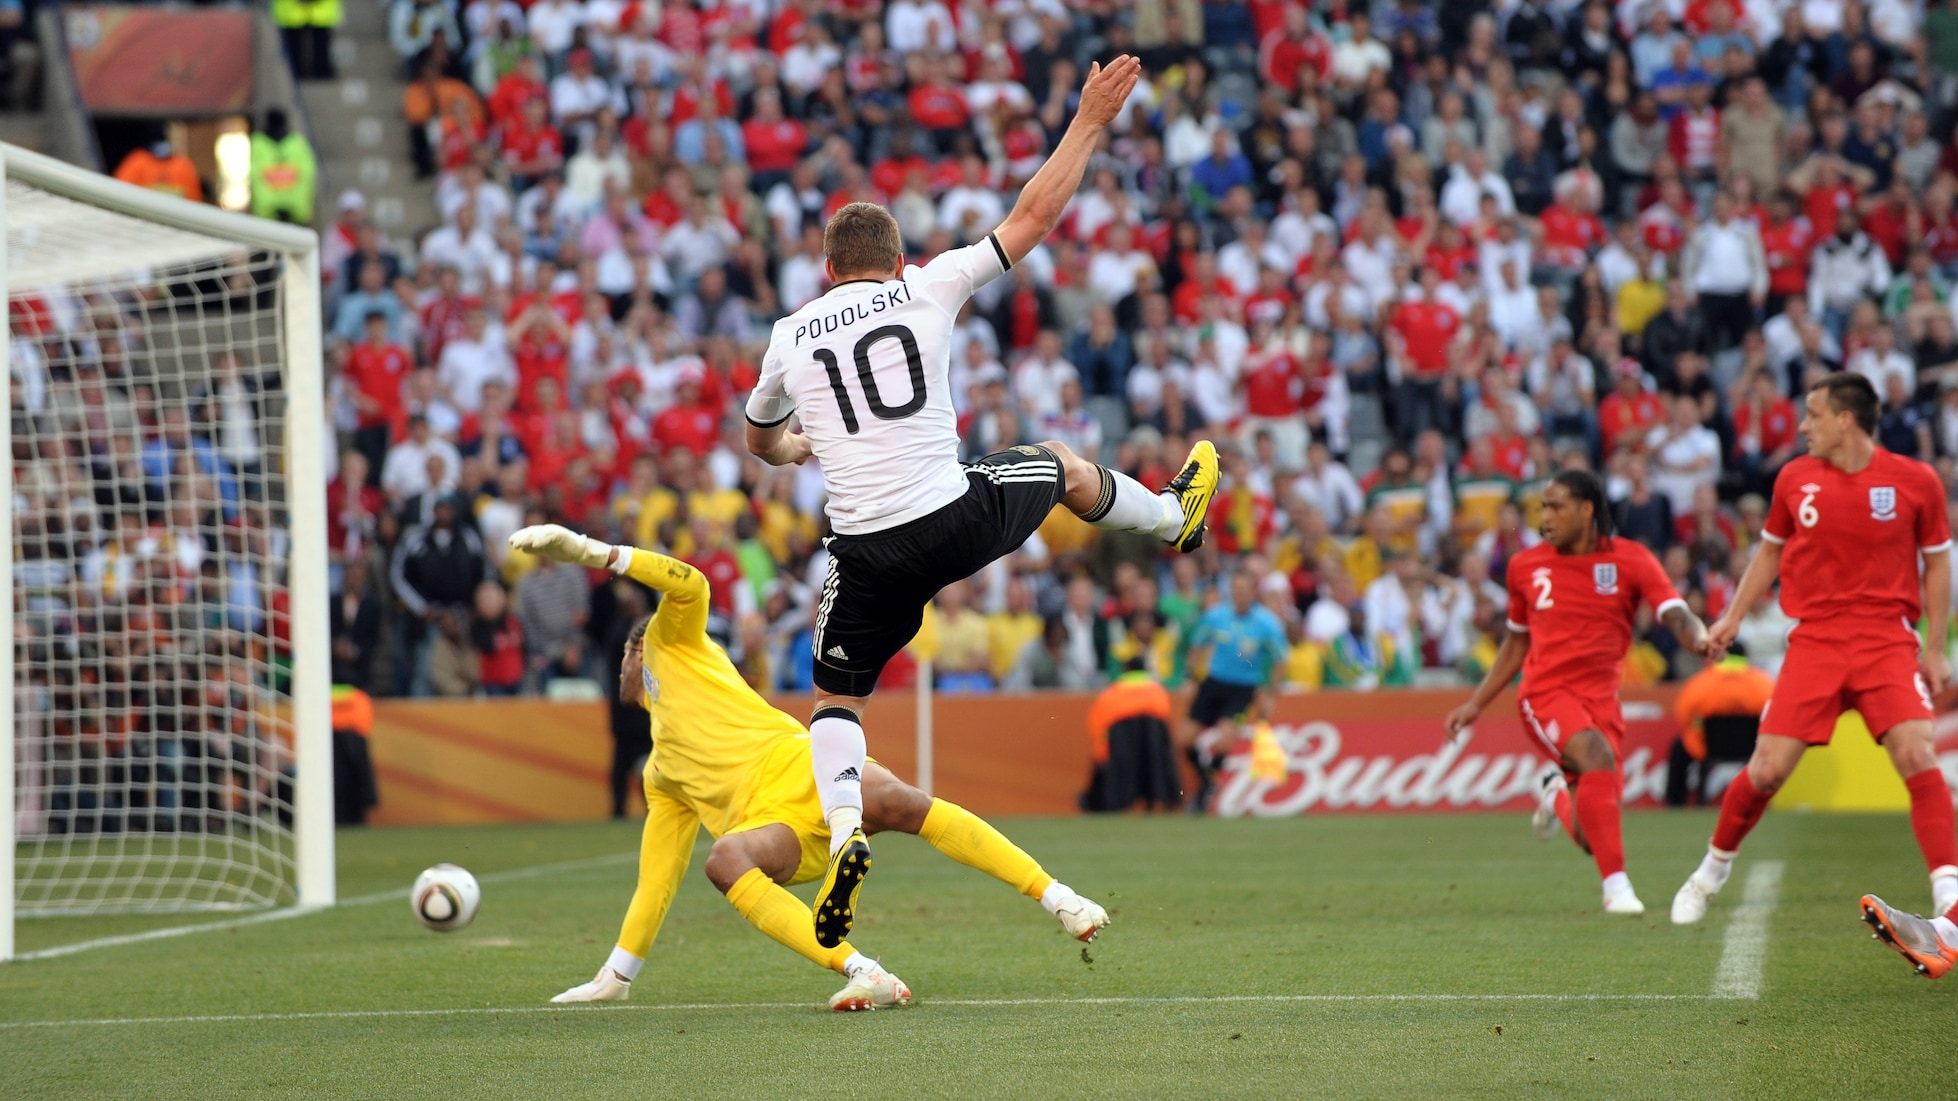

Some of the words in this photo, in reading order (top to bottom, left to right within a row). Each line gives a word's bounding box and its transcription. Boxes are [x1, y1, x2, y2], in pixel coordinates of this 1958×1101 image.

[795, 283, 912, 347] PODOLSKI
[812, 324, 927, 435] 10
[1798, 493, 1819, 528] 6
[1532, 575, 1555, 610] 2
